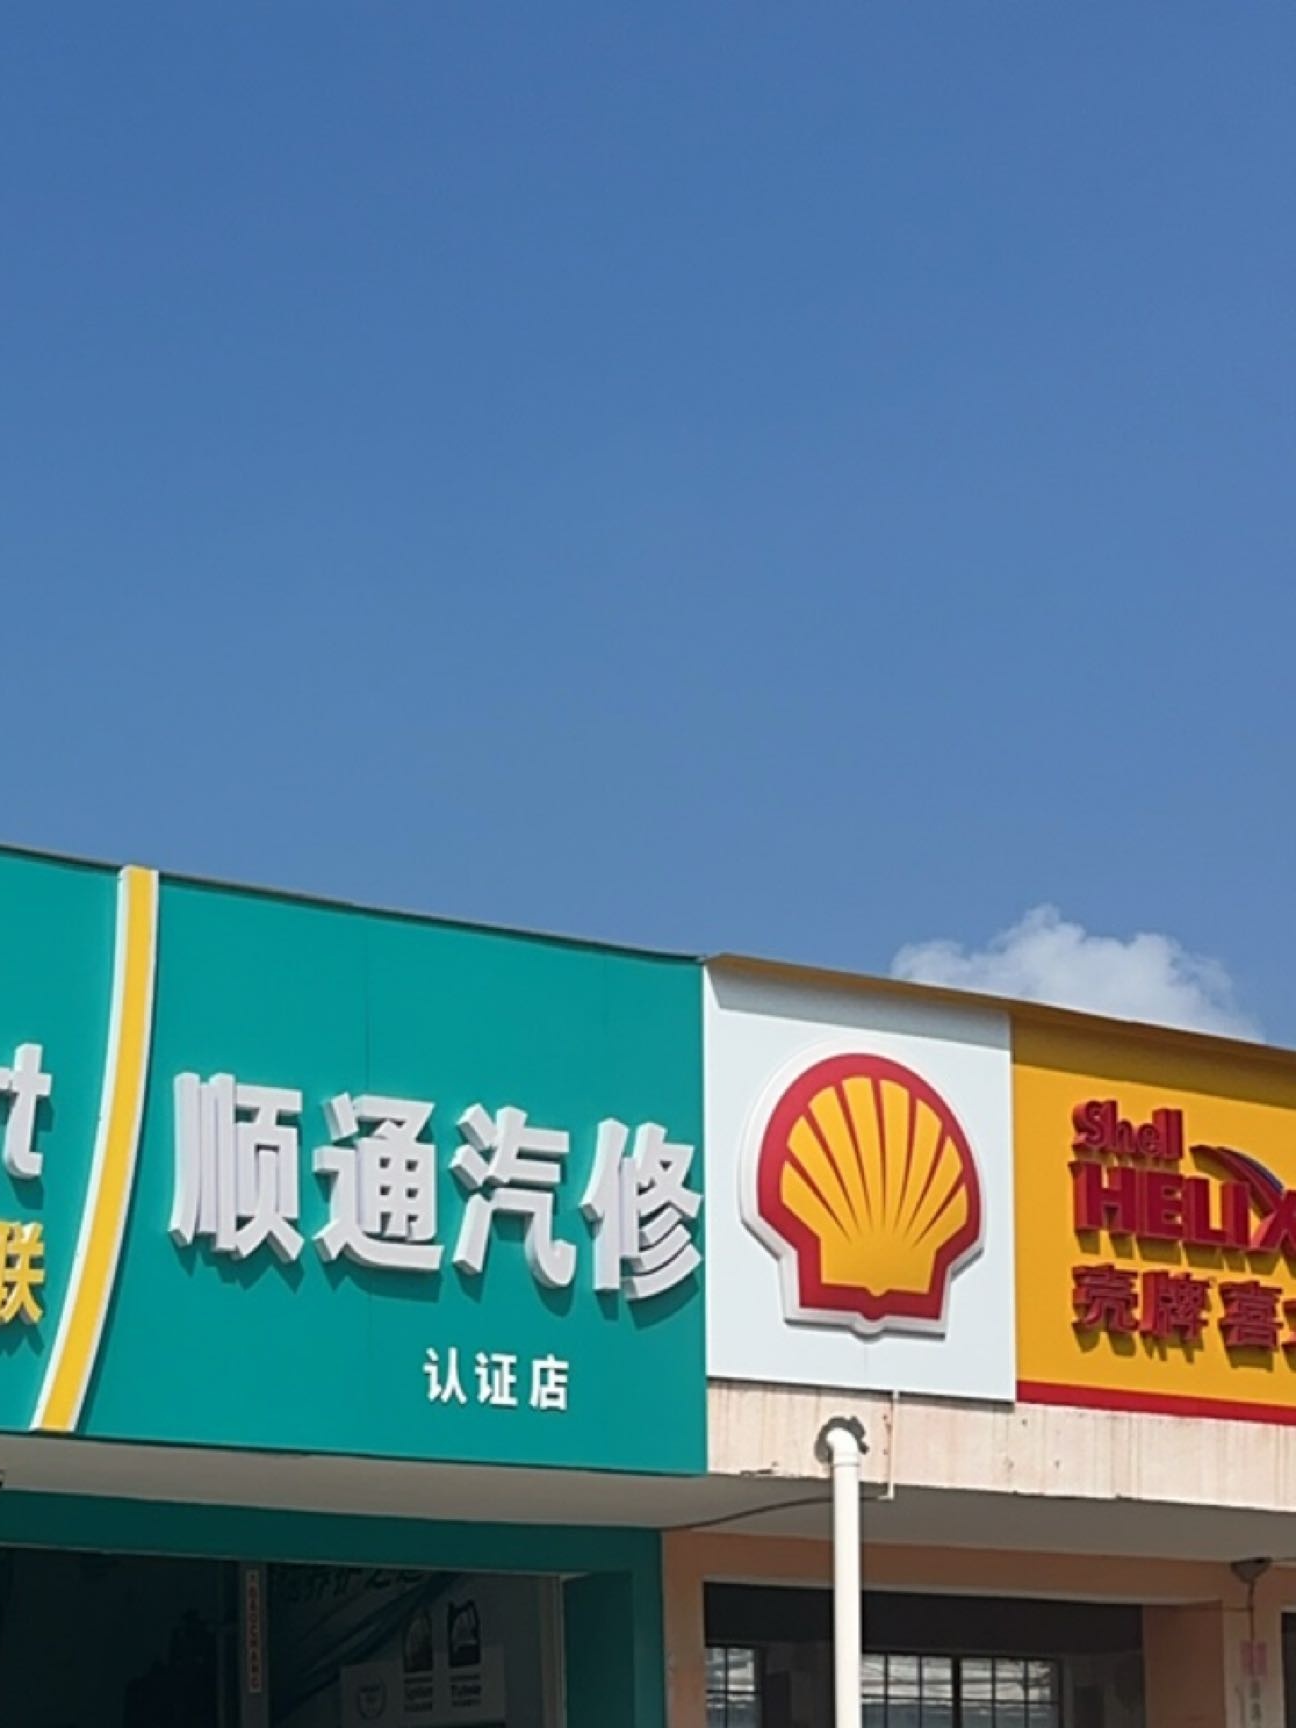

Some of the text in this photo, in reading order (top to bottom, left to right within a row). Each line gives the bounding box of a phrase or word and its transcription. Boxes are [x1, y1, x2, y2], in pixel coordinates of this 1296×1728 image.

[1071, 1099, 1184, 1160] Shell
[168, 1072, 703, 1300] 顺通汽修
[1071, 1262, 1296, 1351] 壳牌喜
[423, 1348, 570, 1411] 认证店
